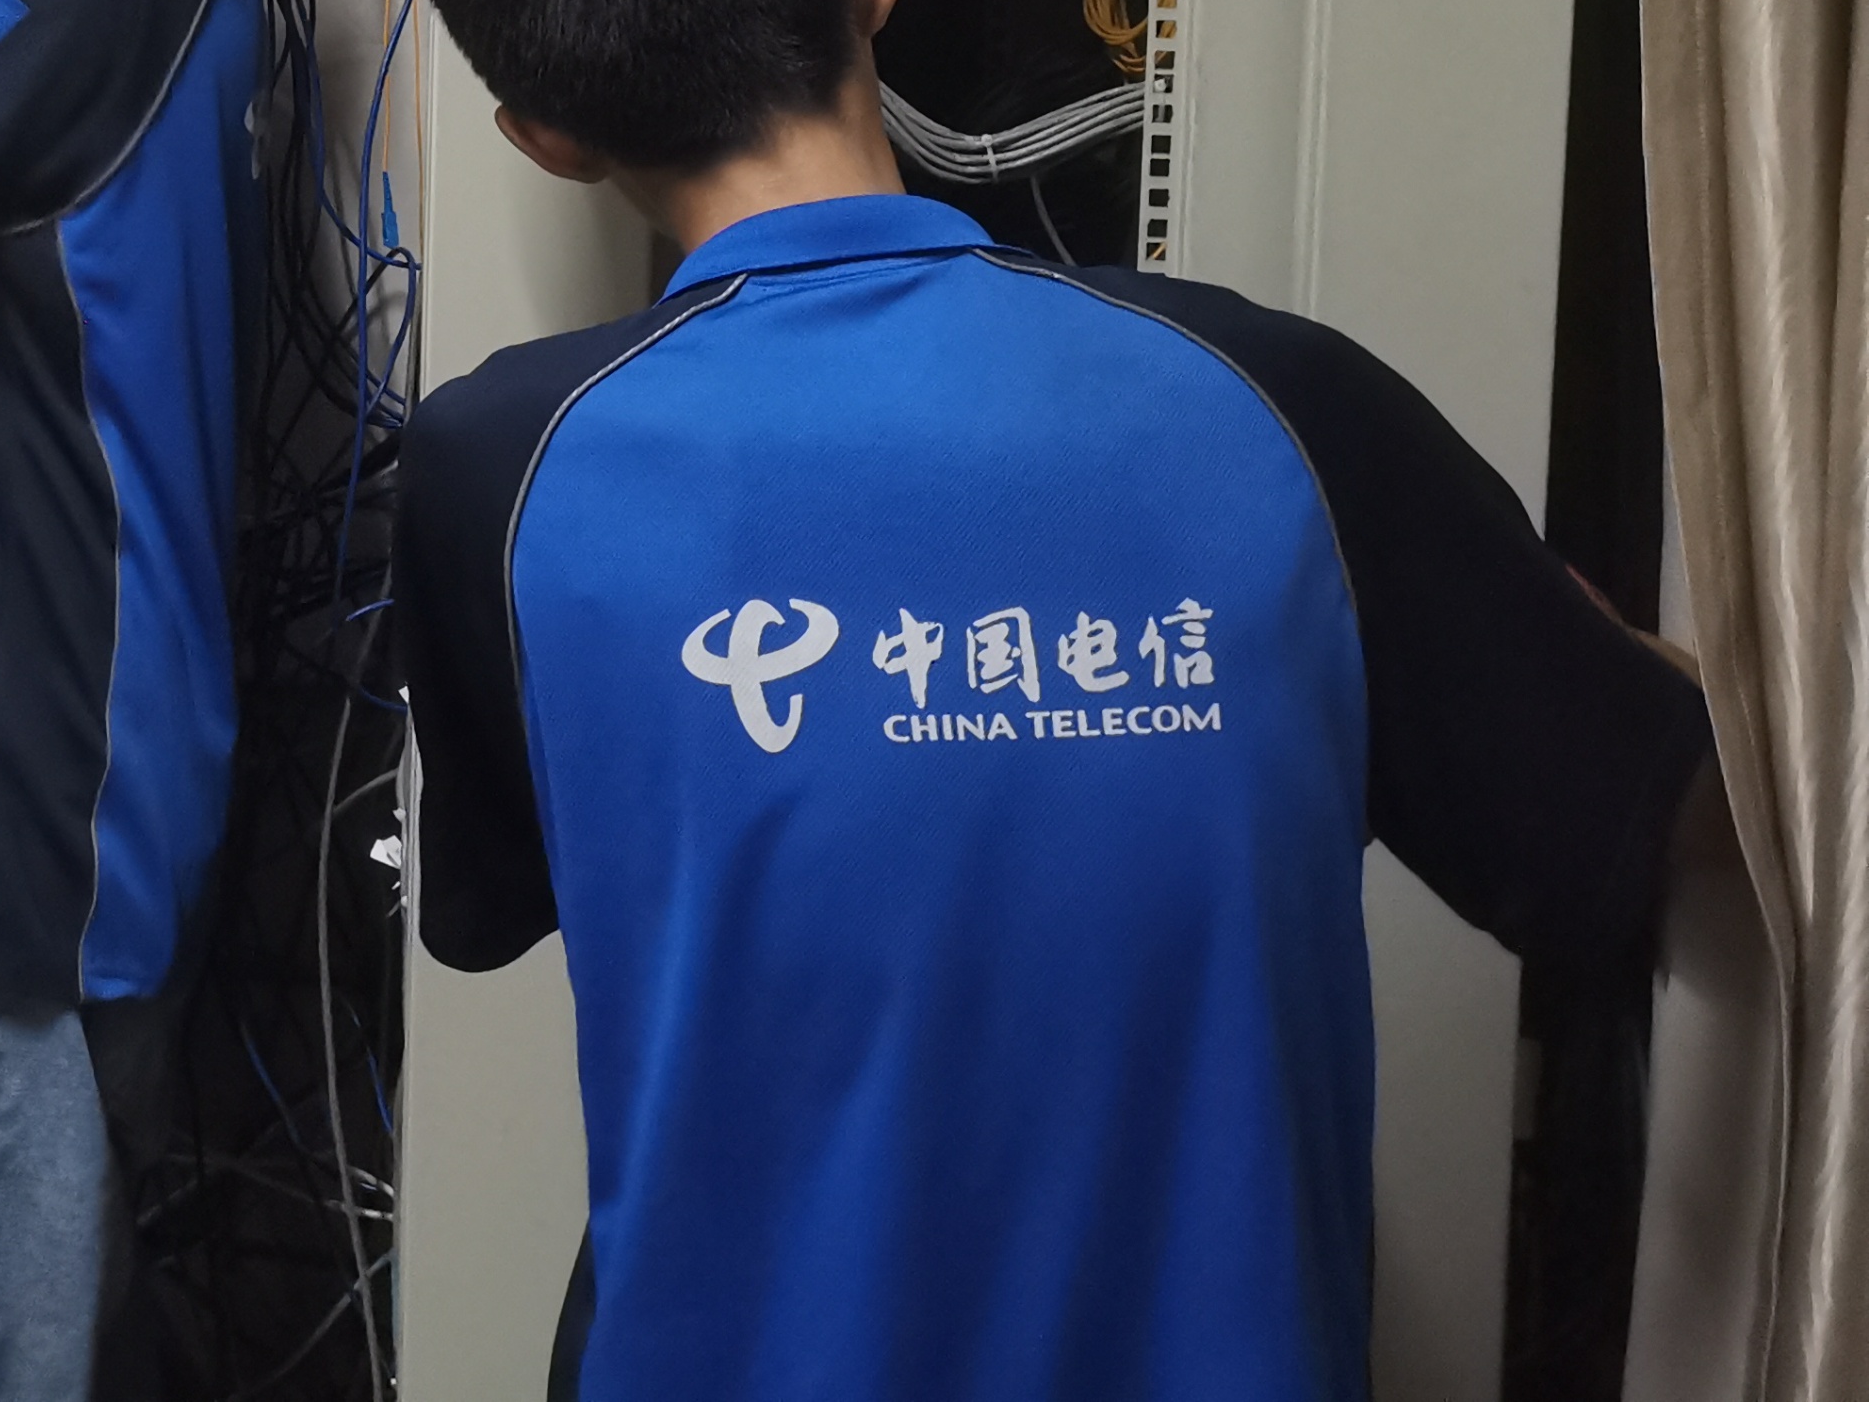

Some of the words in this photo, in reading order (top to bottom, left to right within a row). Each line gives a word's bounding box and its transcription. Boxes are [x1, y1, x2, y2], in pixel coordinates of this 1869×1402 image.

[872, 597, 1216, 709] 中国电信
[882, 712, 1018, 744] CHINA
[1025, 702, 1222, 739] TELECOM
